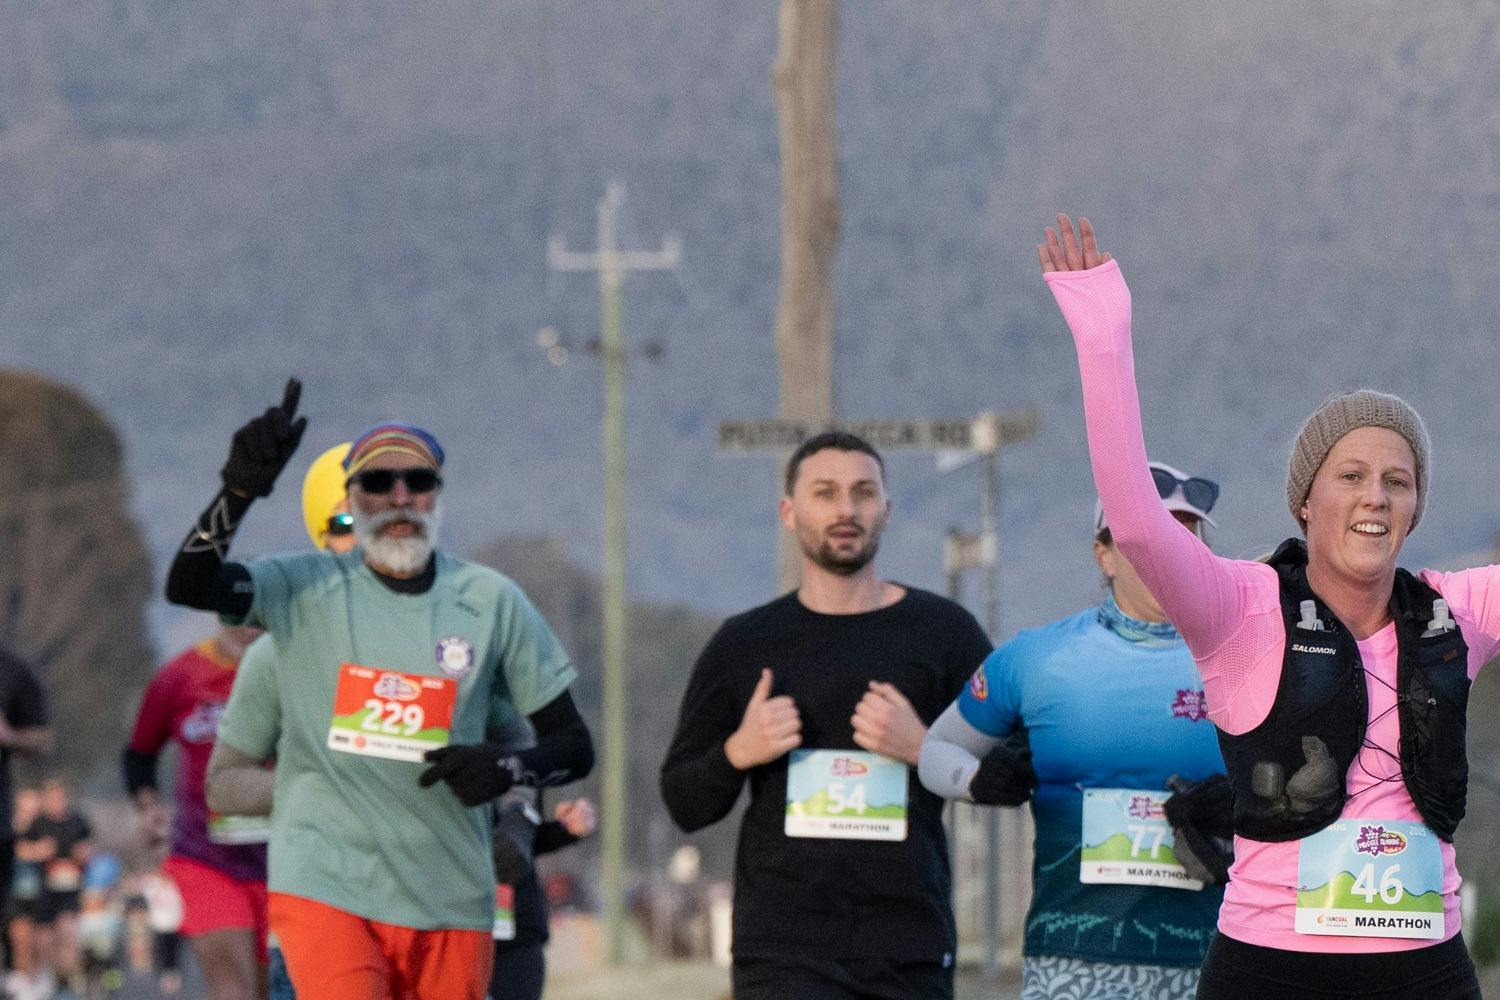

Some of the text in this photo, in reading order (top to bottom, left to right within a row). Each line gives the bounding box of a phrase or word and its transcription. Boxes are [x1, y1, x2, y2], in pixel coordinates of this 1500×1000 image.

[1291, 643, 1337, 656] SALOMON
[361, 698, 425, 737] 229
[827, 781, 866, 815] 54
[1127, 824, 1167, 859] 77
[1350, 862, 1404, 905] 46
[1355, 916, 1432, 929] MARATHON
